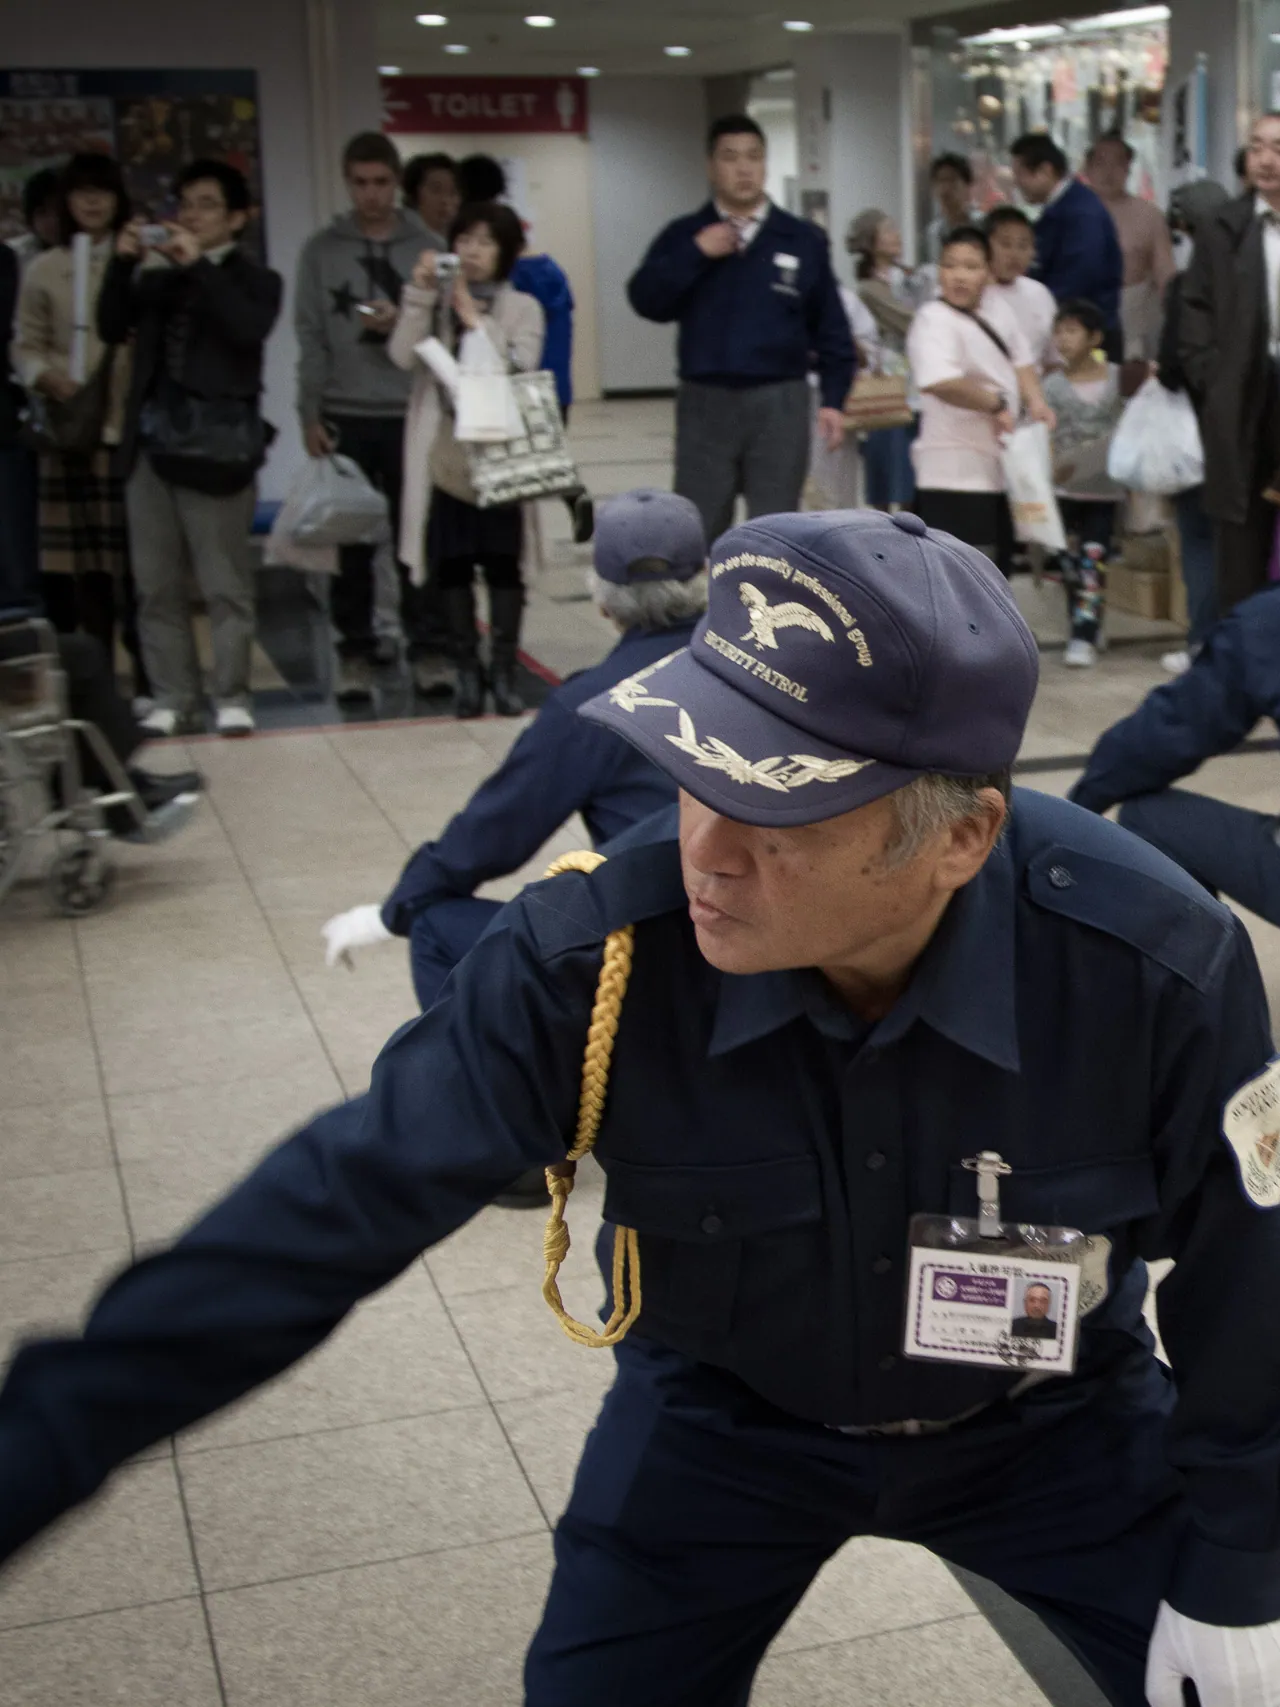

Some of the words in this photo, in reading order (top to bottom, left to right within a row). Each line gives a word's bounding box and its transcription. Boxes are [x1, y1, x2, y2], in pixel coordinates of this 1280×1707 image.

[425, 91, 539, 119] TOILET
[791, 567, 859, 628] professional
[846, 627, 874, 667] group
[703, 628, 758, 671] SECURITY
[750, 659, 809, 703] PATROL
